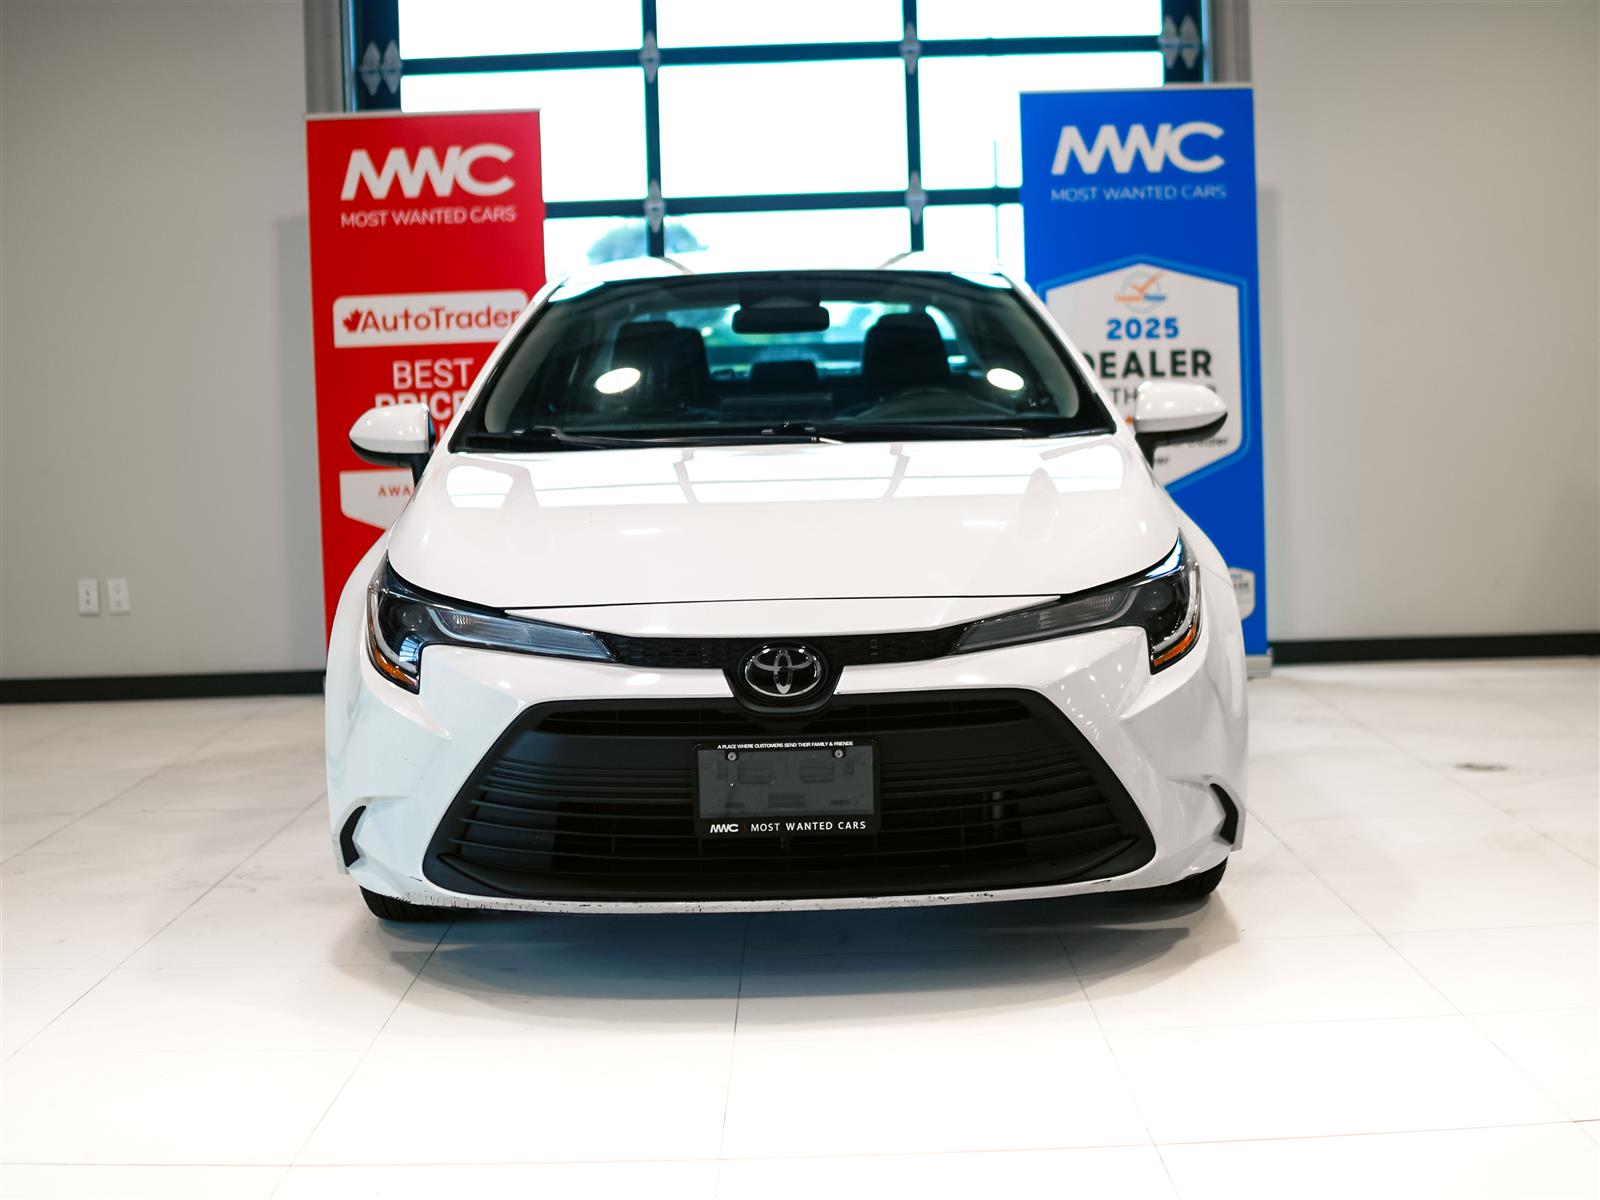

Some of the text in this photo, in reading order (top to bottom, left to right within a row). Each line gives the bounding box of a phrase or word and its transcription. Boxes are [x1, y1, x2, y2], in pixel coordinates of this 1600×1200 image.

[1050, 121, 1225, 176] MWC
[340, 143, 516, 201] MWC
[1050, 183, 1227, 202] MOST WANTED CARS
[340, 204, 517, 229] MOST WANTED CARS
[361, 304, 520, 334] AutoTrader
[1106, 316, 1180, 341] 2025
[392, 357, 475, 390] BEST
[378, 484, 415, 497] AWA
[709, 820, 867, 834] MWC MOST WANTED CARS
